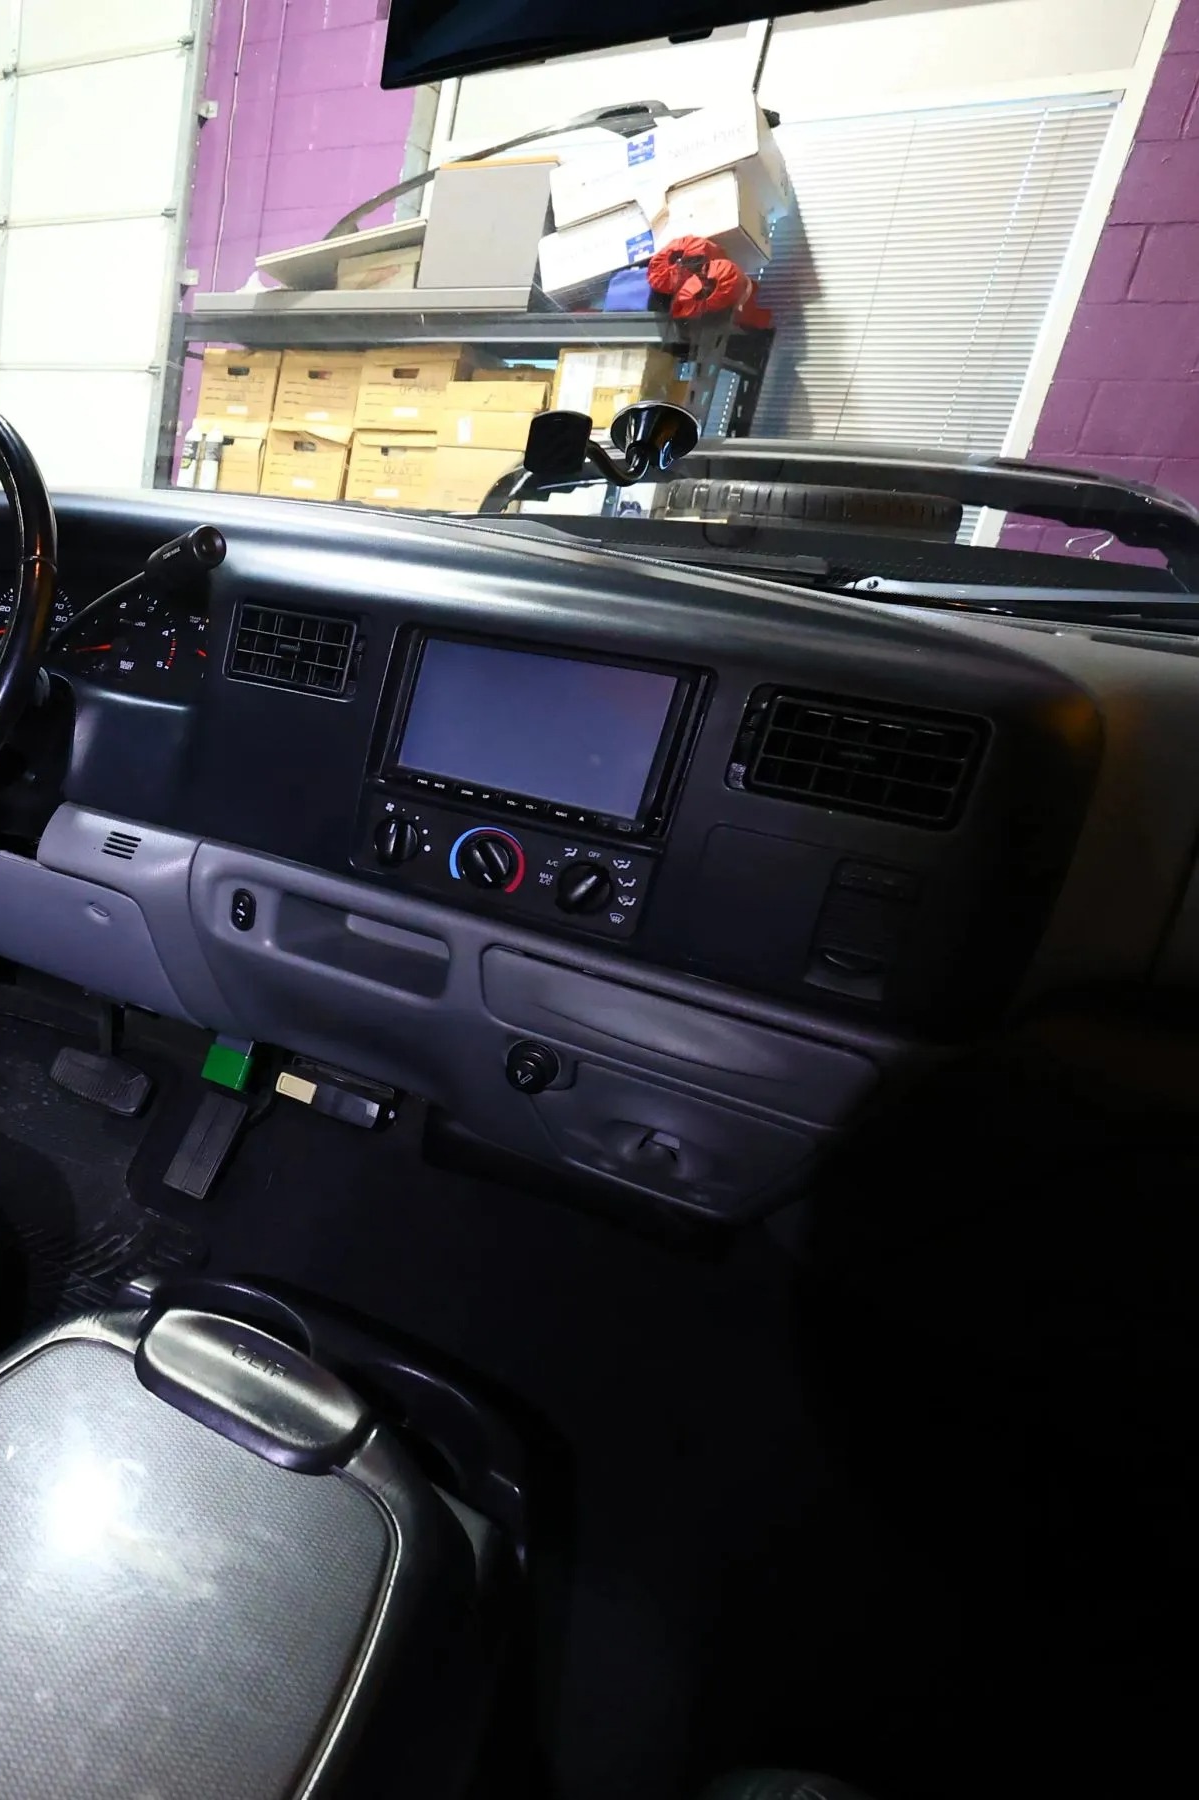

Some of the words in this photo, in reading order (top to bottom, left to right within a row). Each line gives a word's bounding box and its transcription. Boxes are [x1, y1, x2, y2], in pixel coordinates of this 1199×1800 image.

[0, 605, 12, 613] 20
[55, 615, 68, 623] 80
[546, 859, 559, 867] A/C
[539, 871, 554, 881] MAX
